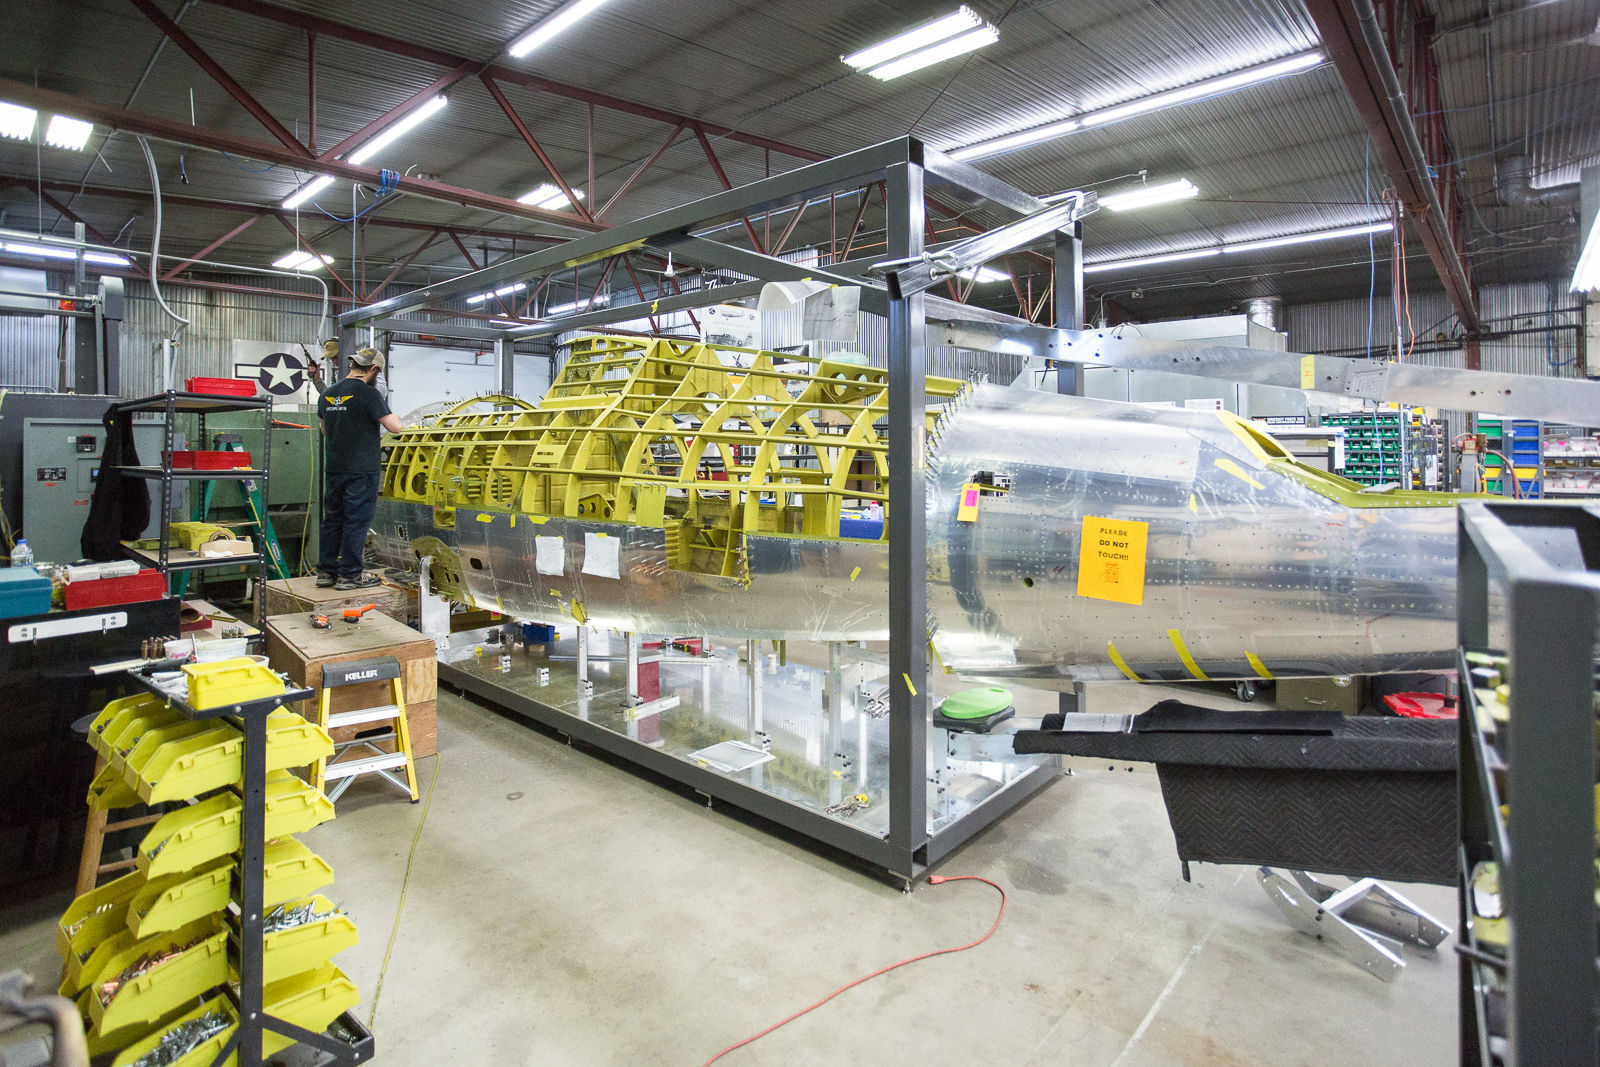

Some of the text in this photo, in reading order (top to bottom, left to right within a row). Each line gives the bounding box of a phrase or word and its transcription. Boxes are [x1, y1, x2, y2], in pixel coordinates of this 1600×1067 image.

[1100, 527, 1128, 536] PLEASE
[1099, 539, 1129, 549] DO NOT
[344, 669, 379, 682] KELLER
